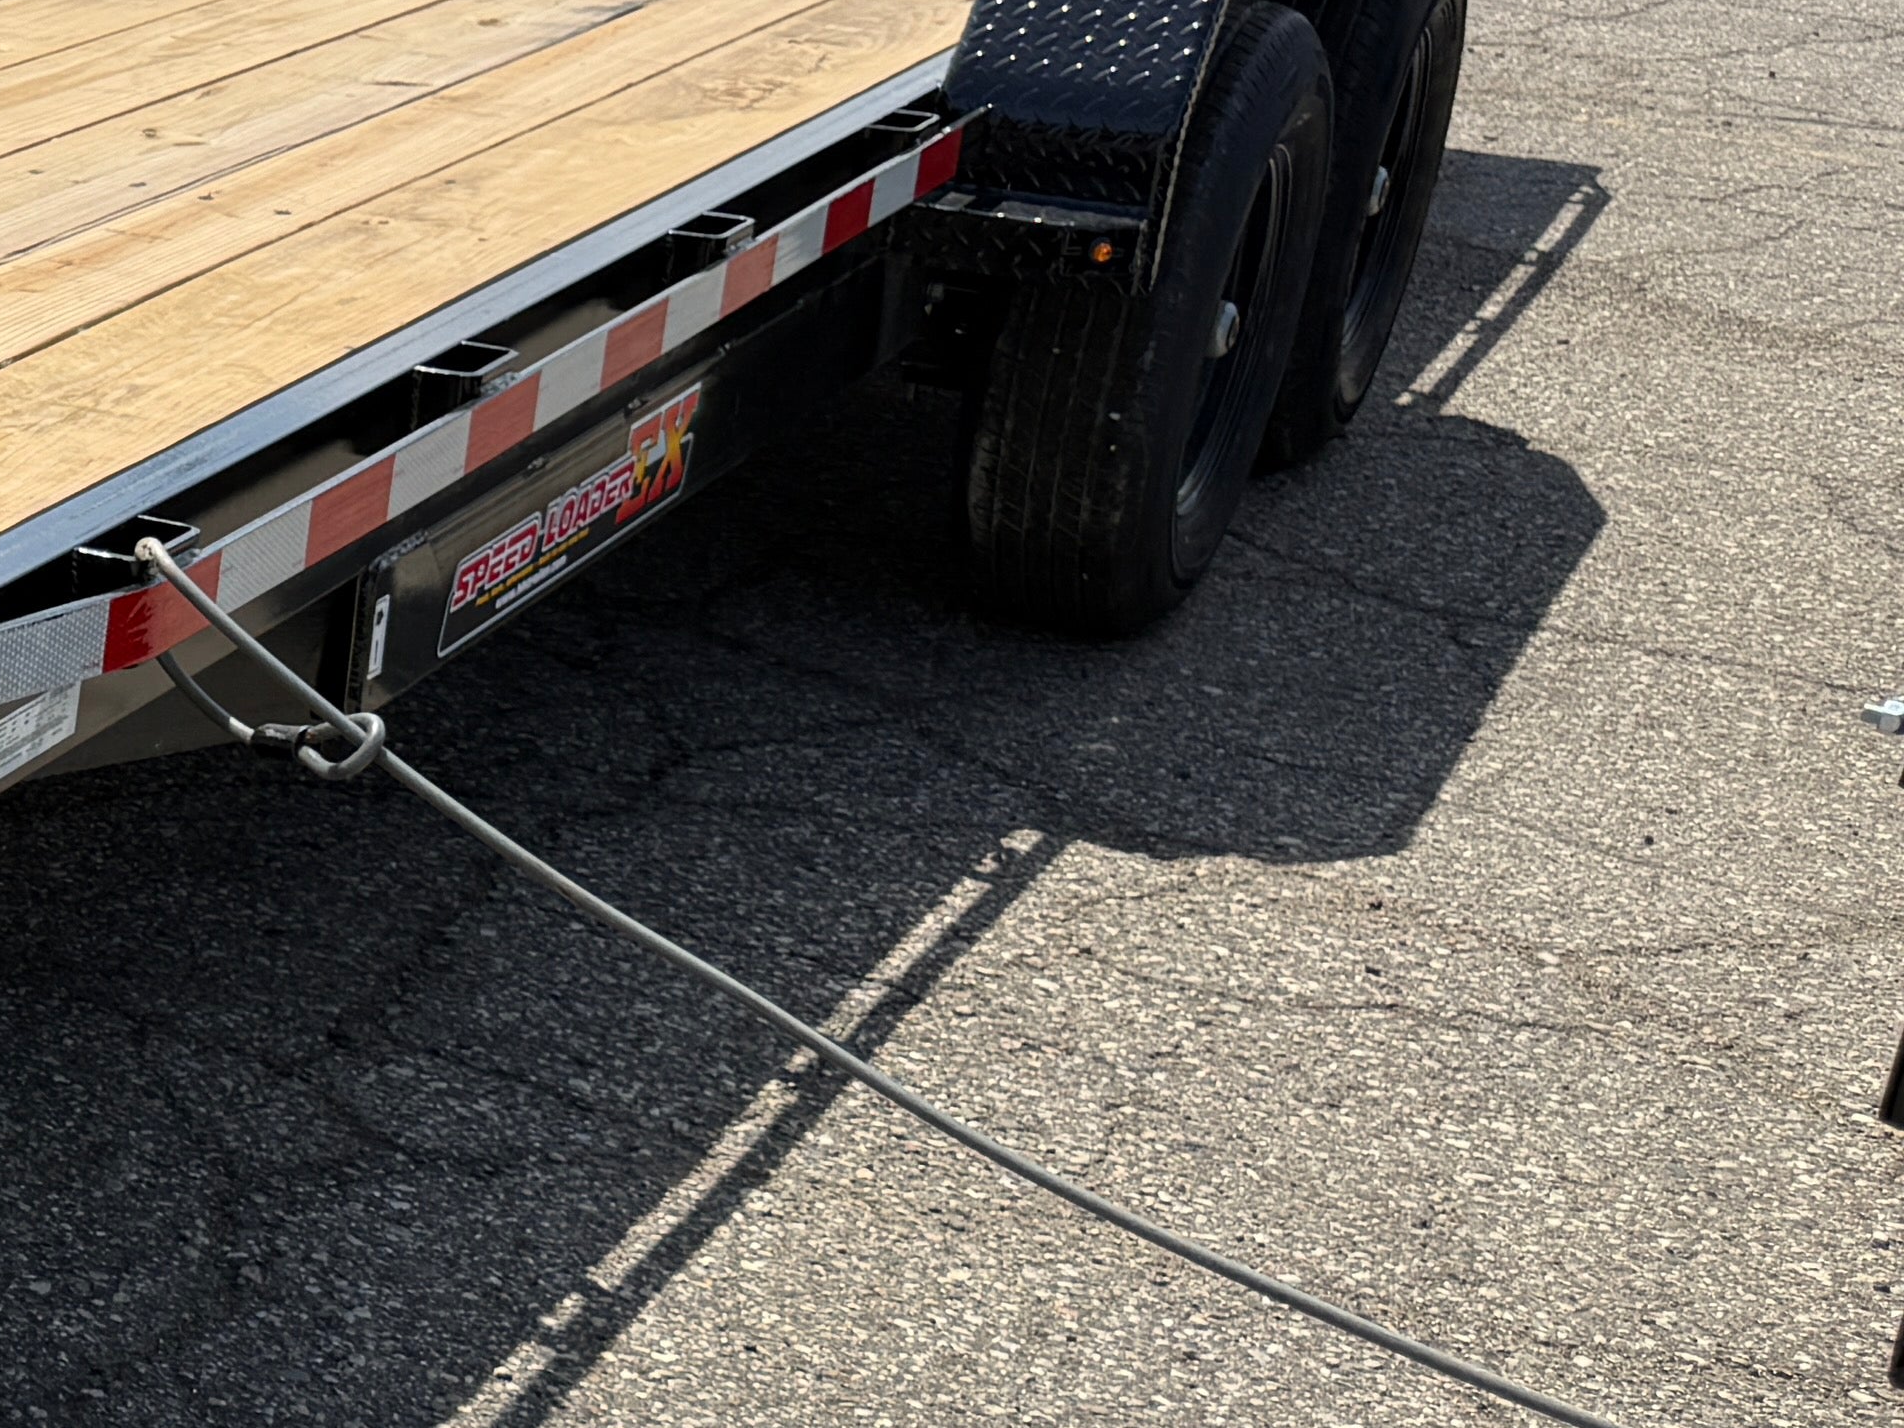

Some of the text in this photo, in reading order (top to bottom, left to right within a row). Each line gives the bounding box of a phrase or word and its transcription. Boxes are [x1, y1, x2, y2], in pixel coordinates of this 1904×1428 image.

[450, 518, 540, 612] SPEED
[542, 459, 635, 552] LOADER
[616, 386, 702, 525] EX
